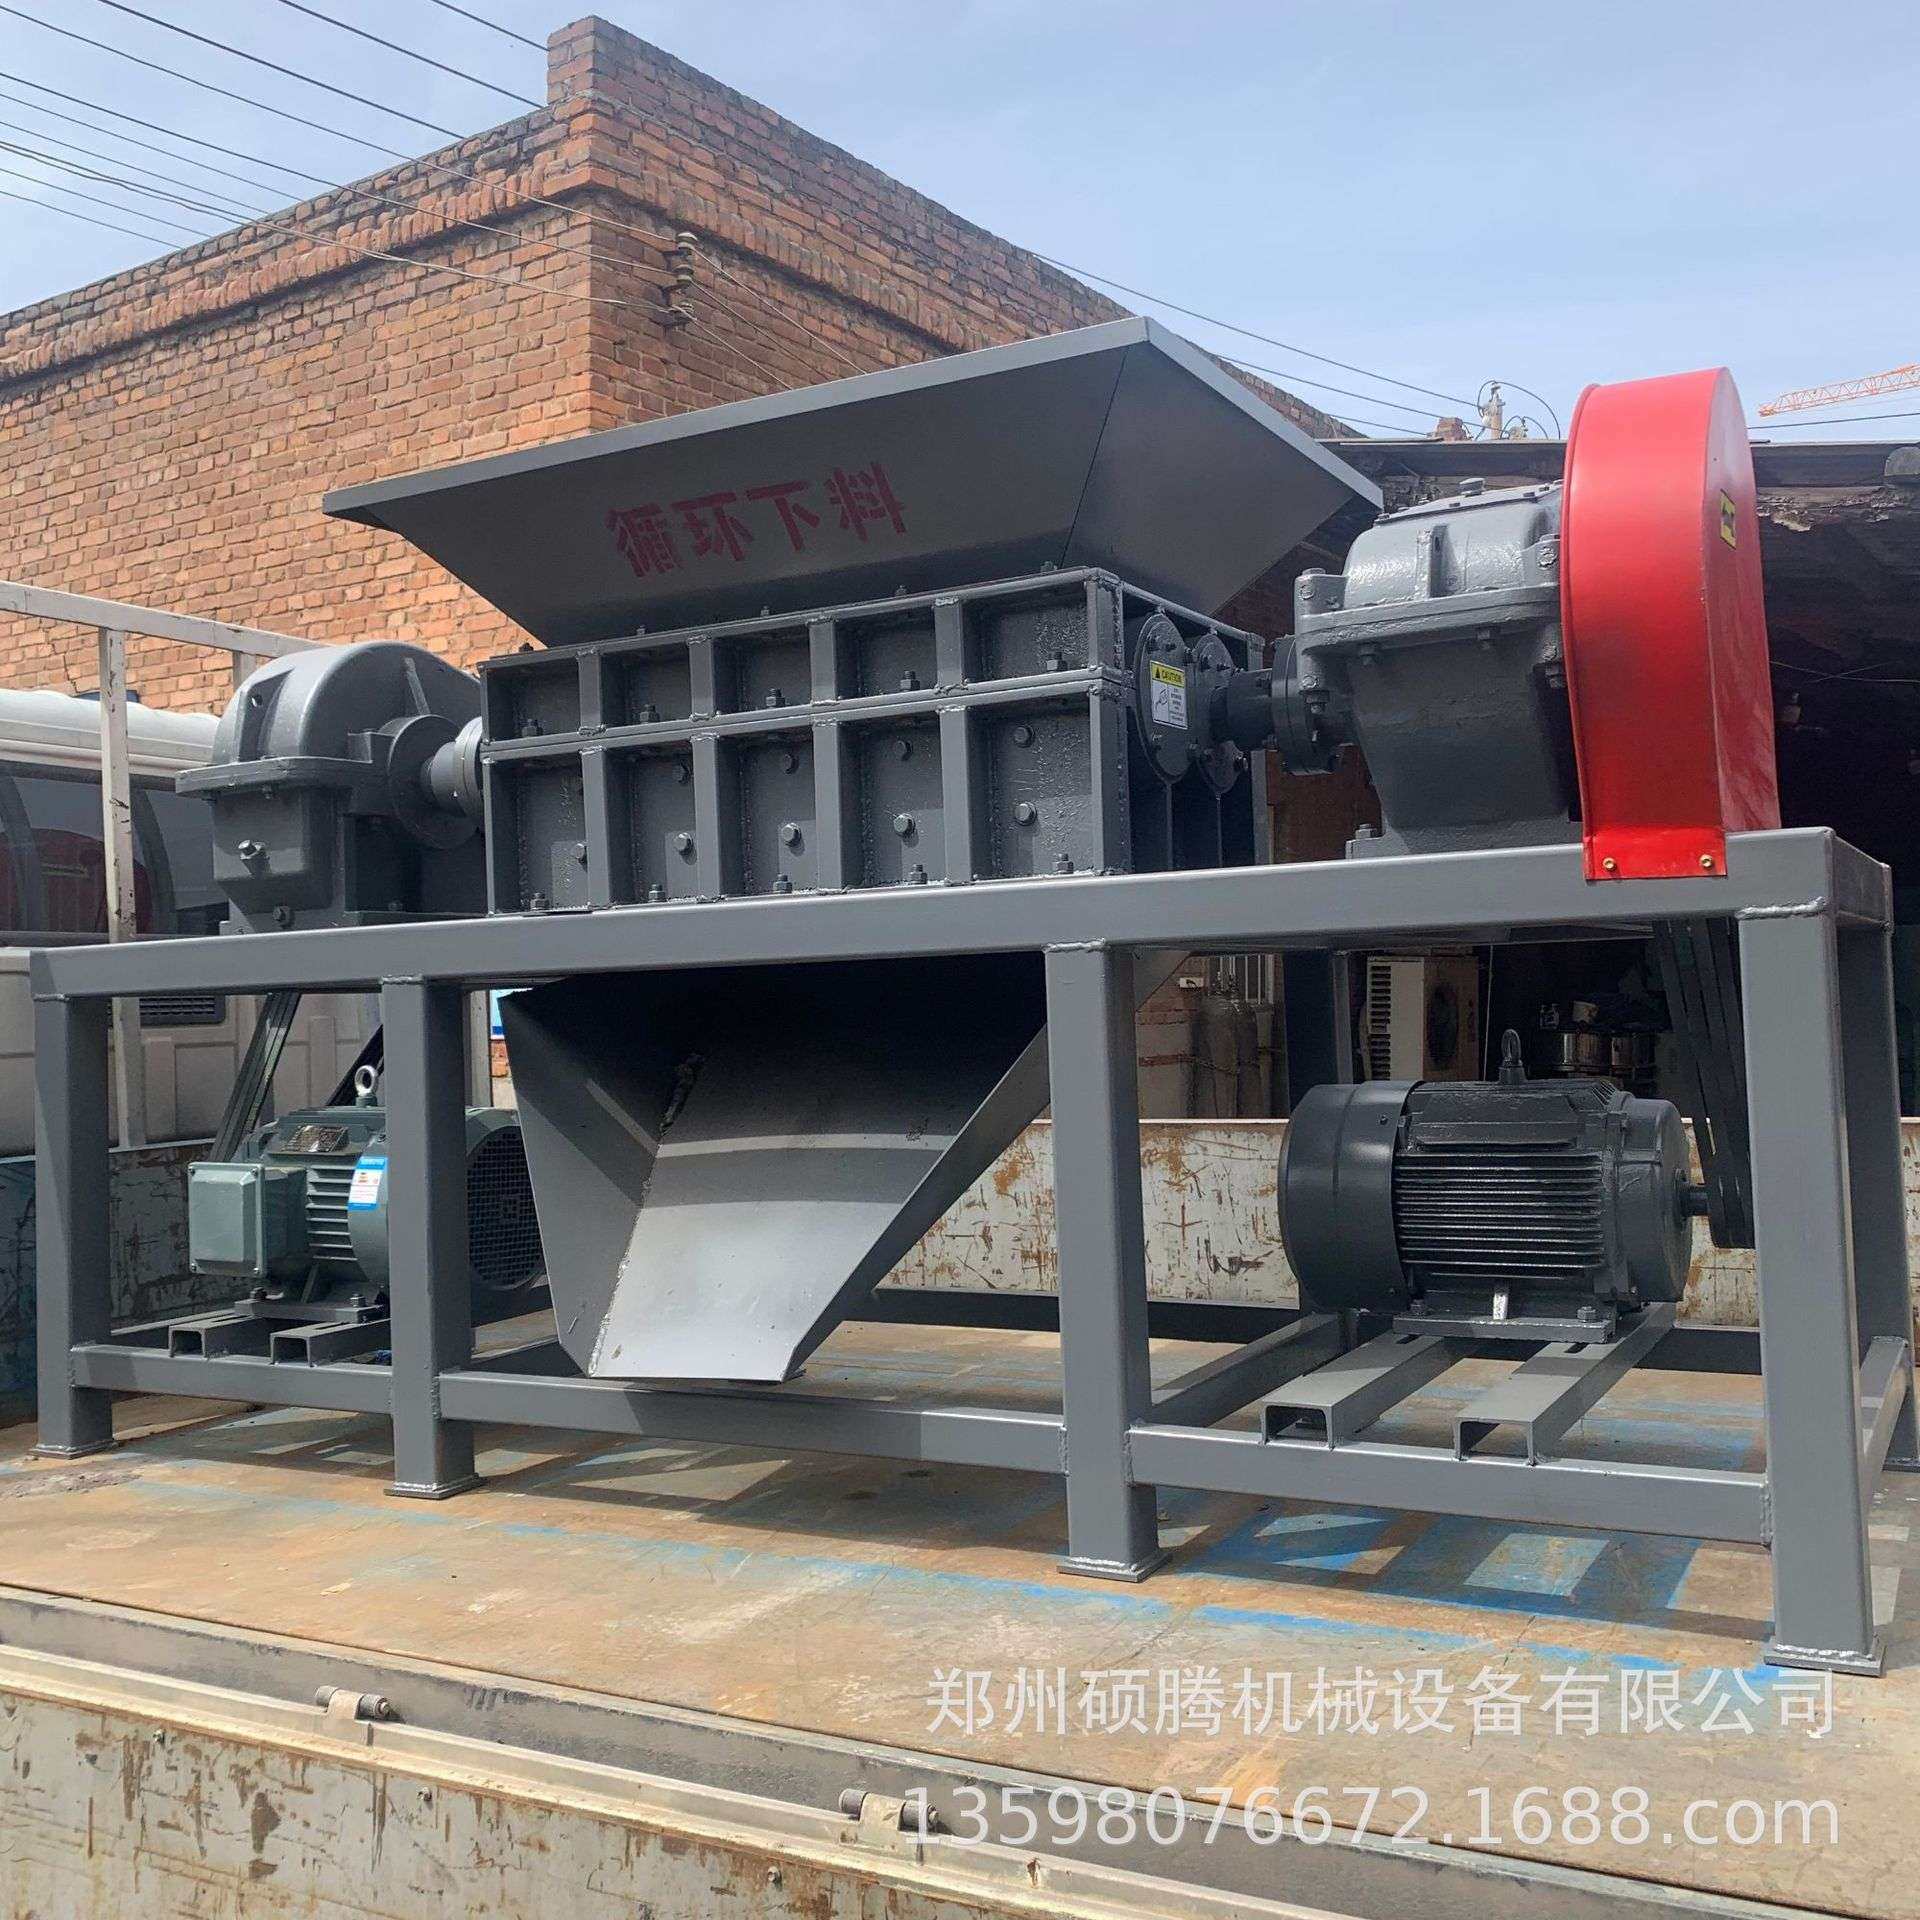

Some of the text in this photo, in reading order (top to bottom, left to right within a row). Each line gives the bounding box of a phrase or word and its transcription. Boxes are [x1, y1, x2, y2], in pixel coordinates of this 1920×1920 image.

[605, 461, 907, 577] 循环下料
[1161, 670, 1182, 682] CAUTION
